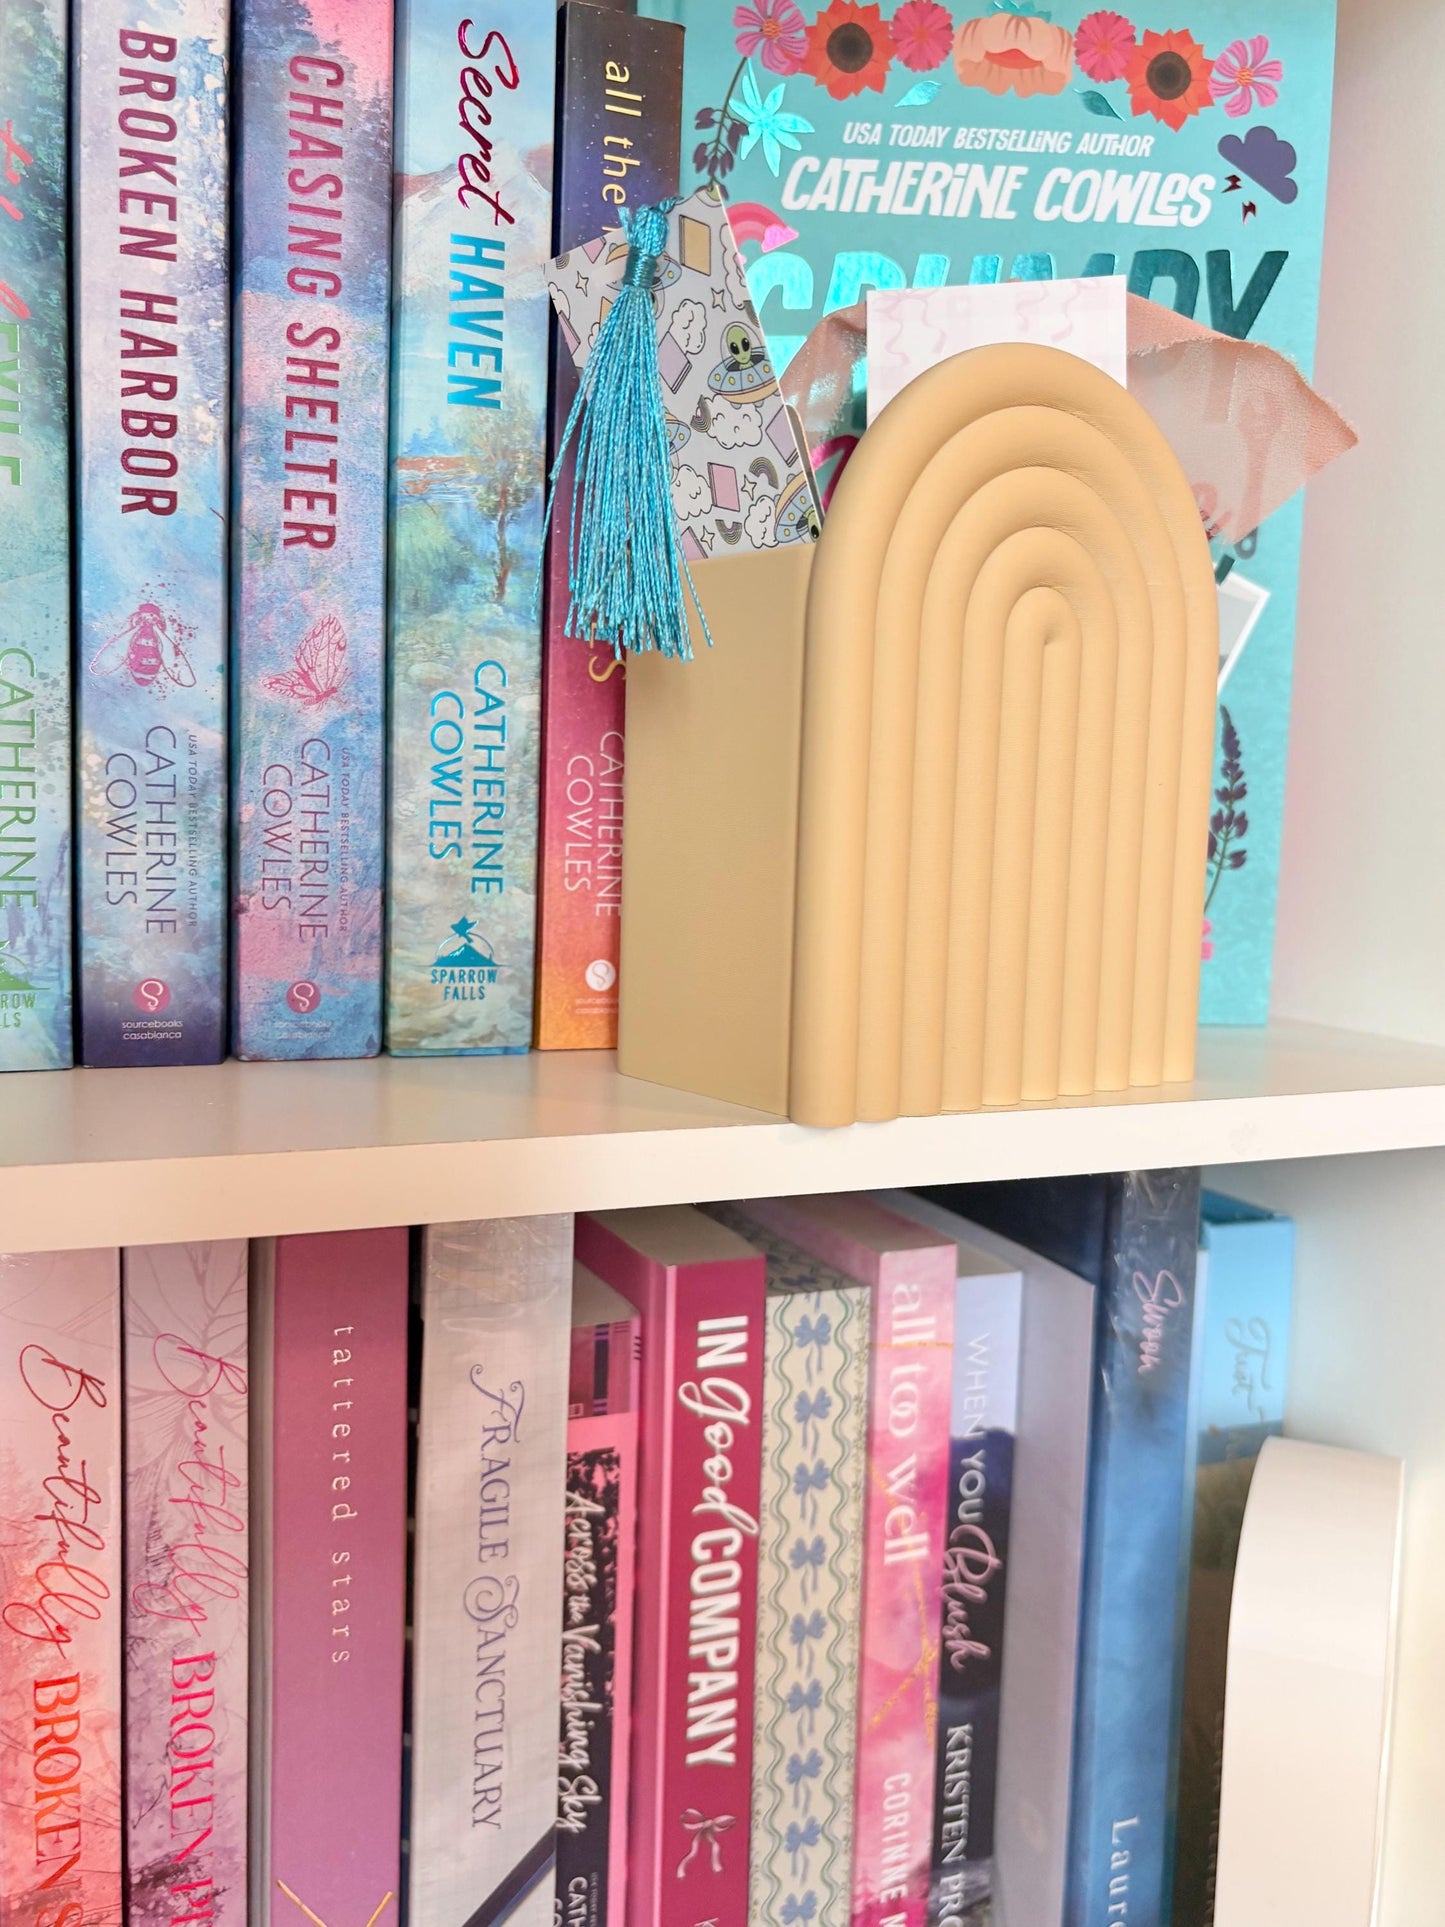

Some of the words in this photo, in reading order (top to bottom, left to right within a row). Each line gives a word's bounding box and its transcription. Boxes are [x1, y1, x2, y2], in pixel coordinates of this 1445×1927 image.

[119, 29, 179, 263] BROKEN
[457, 18, 520, 227] Secret
[604, 60, 643, 118] all
[843, 121, 883, 145] USA
[889, 124, 951, 148] TODAY
[1076, 133, 1155, 157] AUTHOR
[286, 55, 345, 299] CHASING
[602, 135, 641, 205] the
[446, 232, 506, 411] HAVEN
[119, 290, 179, 517] HARBOR
[282, 322, 341, 550] SHELTER
[0, 647, 37, 909] CATHERINE
[188, 734, 197, 756] USA
[188, 759, 197, 799] TODAY
[341, 747, 350, 768] USA
[341, 773, 350, 810] TODAY
[428, 690, 466, 861] COWLES
[471, 659, 509, 895] CATHERINE
[105, 753, 137, 906] COWLES
[145, 725, 177, 934] CATHERINE
[188, 802, 198, 876] BESTSELLING
[262, 763, 293, 911] COWLES
[299, 738, 331, 938] CATHERINE
[340, 813, 350, 884] BESTSELLING
[564, 755, 594, 892] COWLES
[188, 881, 198, 927] AUTHOR
[339, 887, 348, 933] AUTHOR
[122, 1019, 183, 1029] sourcebooks
[122, 1030, 182, 1040] casablanca
[430, 968, 498, 985] SPARROW
[443, 985, 486, 1001] FALLS
[696, 1315, 749, 1369] IN
[891, 1282, 937, 1345] all
[331, 1326, 358, 1522] tattered
[887, 1361, 928, 1438] too
[963, 1331, 991, 1441] WHEN
[2, 1344, 110, 1659] Beautifully
[132, 1333, 249, 1637] Beautifully
[678, 1376, 759, 1535] Good
[883, 1453, 930, 1566] well
[957, 1448, 986, 1524] YOU
[331, 1549, 352, 1664] stars
[685, 1527, 743, 1767] COMPANY
[939, 1523, 1002, 1674] Blush
[170, 1651, 216, 1864] BROKEN
[463, 1575, 519, 1830] SANCTUARY
[558, 1623, 603, 1770] Vanishing
[33, 1672, 82, 1891] BROKEN
[556, 1775, 603, 1834] Sky
[879, 1771, 913, 1905] CORINNE
[941, 1723, 974, 1865] KRISTEN
